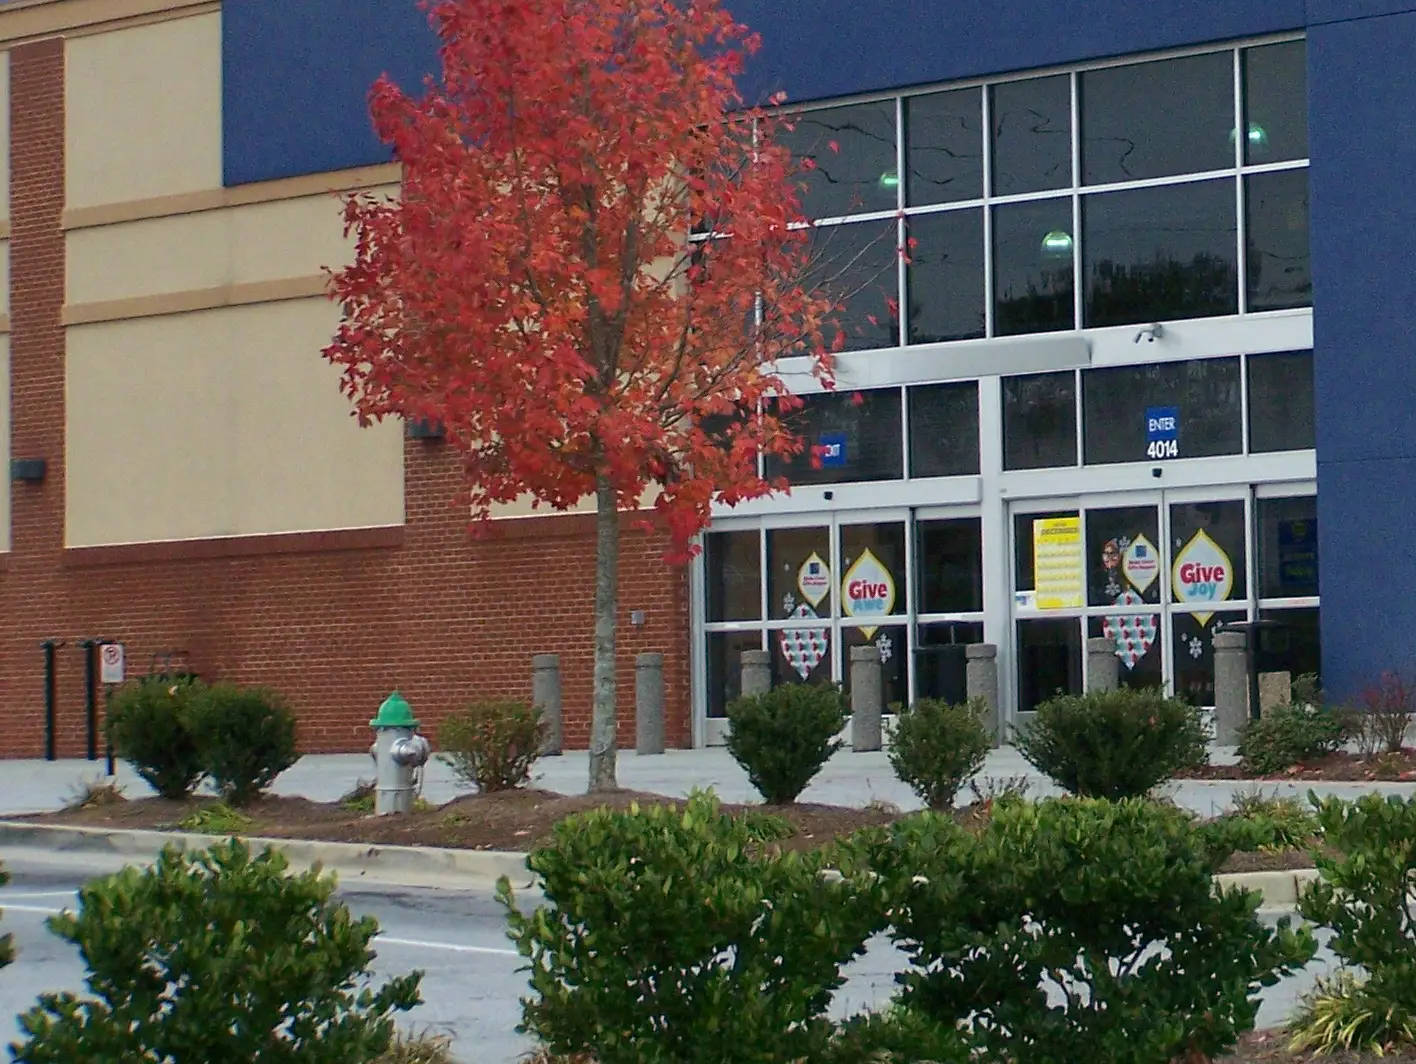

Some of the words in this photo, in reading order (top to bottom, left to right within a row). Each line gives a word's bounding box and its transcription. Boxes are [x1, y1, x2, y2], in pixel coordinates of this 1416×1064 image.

[1148, 416, 1176, 433] ENTER
[1146, 439, 1179, 459] 4014
[1180, 561, 1225, 584] Give
[848, 579, 888, 601] Give
[1187, 582, 1217, 601] Joy
